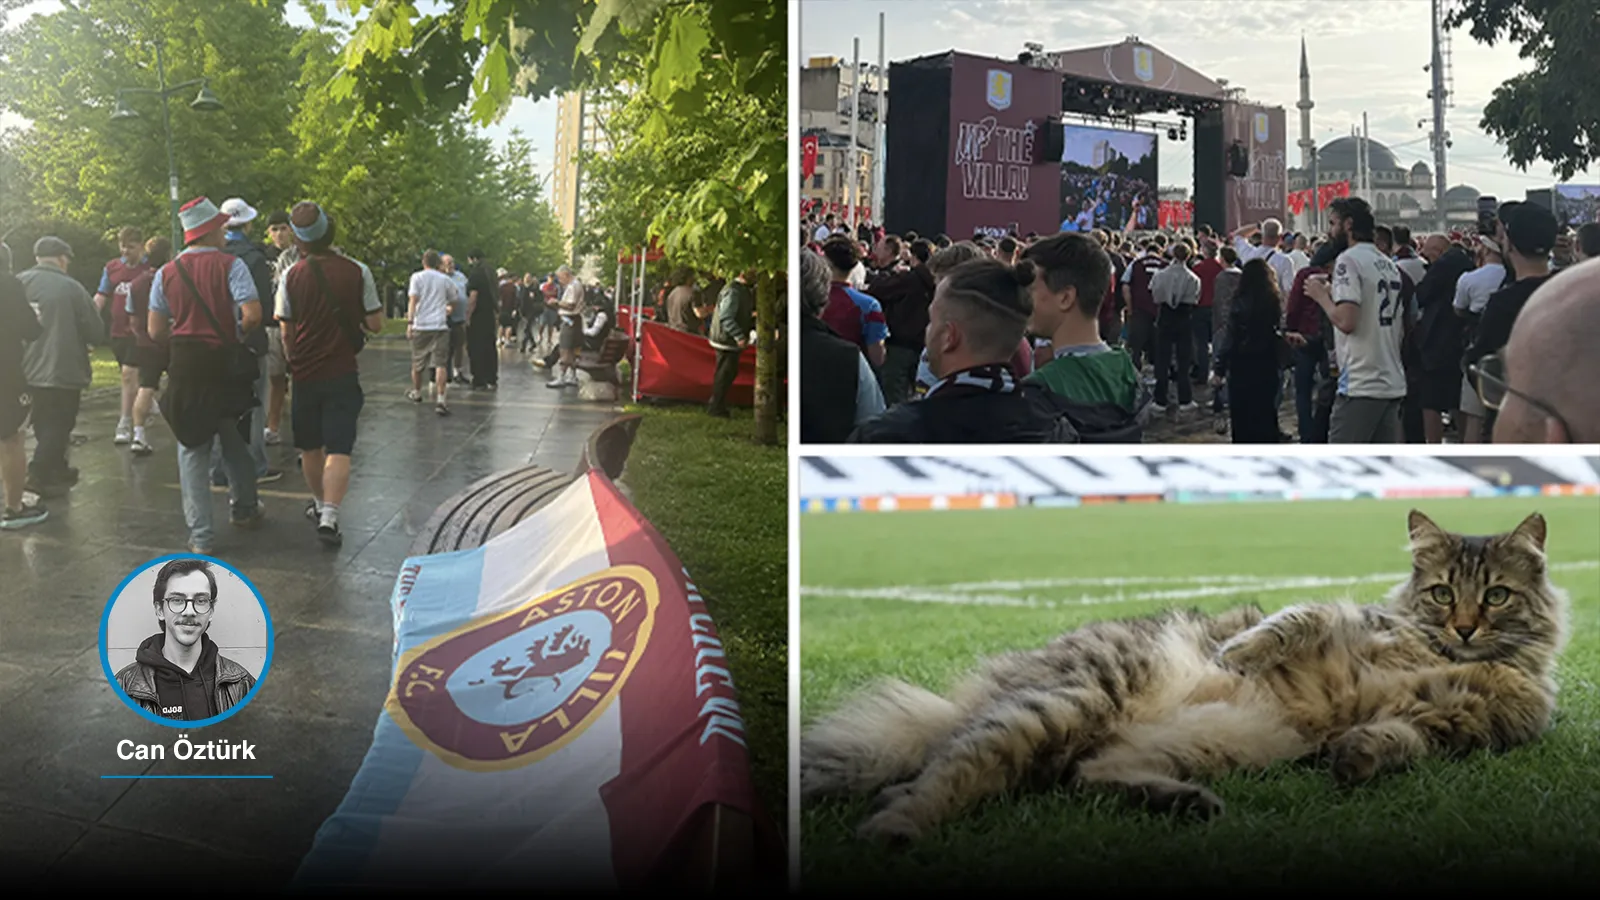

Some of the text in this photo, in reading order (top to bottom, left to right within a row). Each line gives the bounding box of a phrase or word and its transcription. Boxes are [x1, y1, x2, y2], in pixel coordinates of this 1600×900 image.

[955, 116, 1034, 165] UP THE
[961, 162, 1029, 201] VILLA!
[1377, 279, 1402, 326] 27
[519, 581, 641, 628] ASTON
